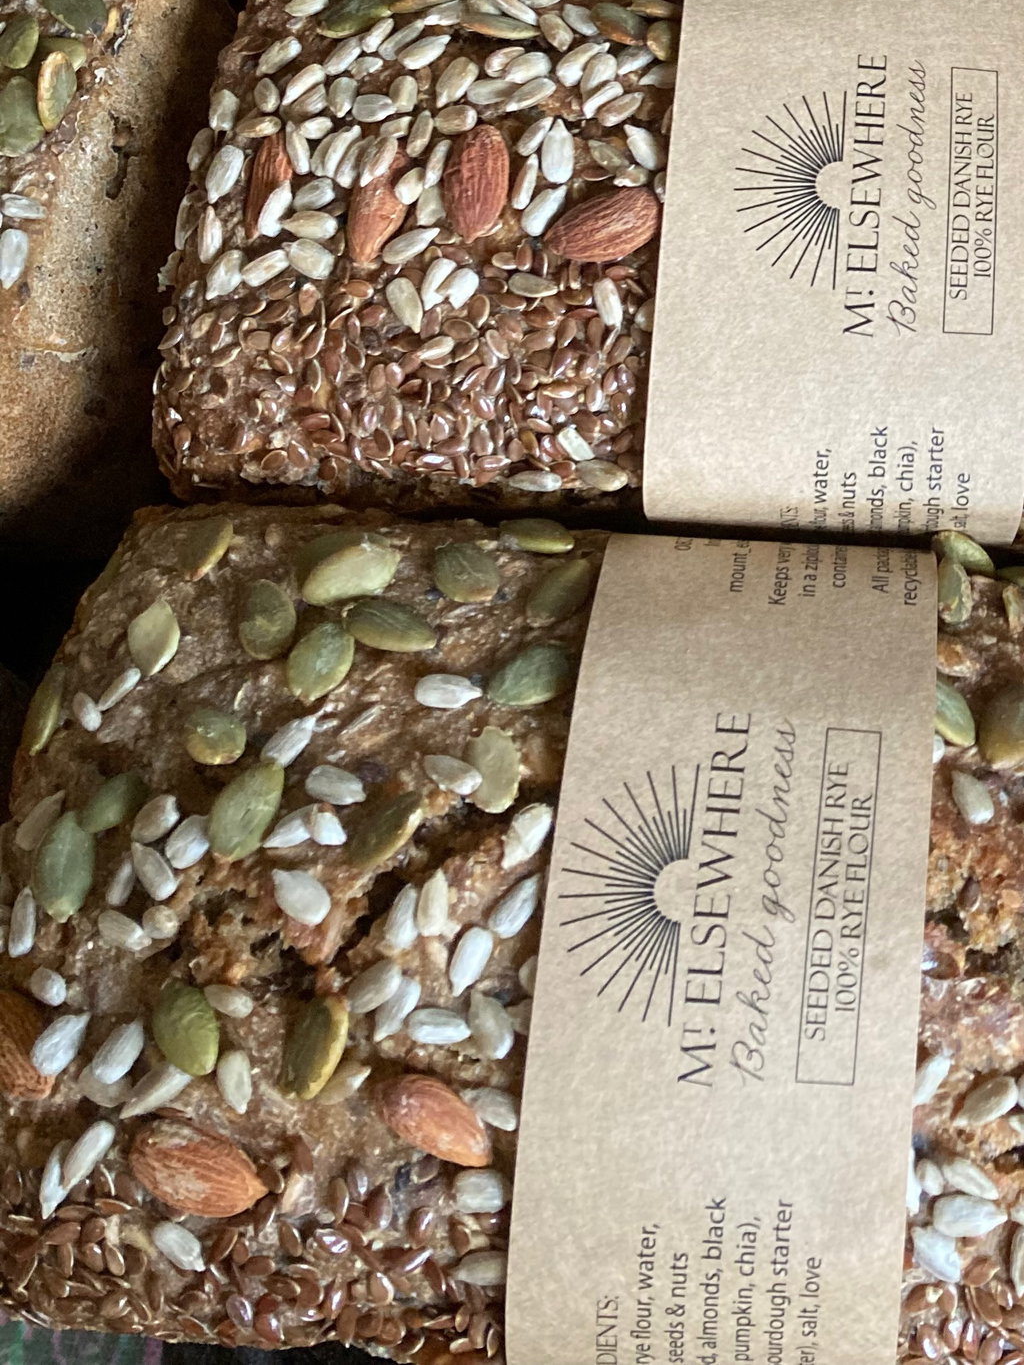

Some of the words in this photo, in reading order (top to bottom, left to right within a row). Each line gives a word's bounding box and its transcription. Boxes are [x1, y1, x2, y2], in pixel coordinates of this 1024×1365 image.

[896, 59, 937, 210] goodness
[955, 91, 973, 126] RYE
[846, 53, 887, 274] ELSEWHERE
[953, 127, 972, 209] DANISH
[976, 113, 995, 180] FLOUR
[975, 185, 994, 224] RYE
[886, 211, 920, 336] Baked
[949, 214, 971, 301] SEEDED
[973, 228, 992, 279] 100%
[812, 447, 832, 504] water,
[869, 426, 889, 478] black
[897, 440, 918, 492] chia),
[927, 427, 946, 491] starter
[842, 471, 857, 509] nuts
[953, 472, 971, 511] love
[768, 564, 792, 607] Keeps
[797, 584, 815, 598] in
[804, 573, 817, 582] a
[872, 575, 889, 594] All
[825, 761, 849, 810] RYE
[684, 712, 752, 1007] ELSEWHERE
[845, 794, 873, 884] FLOUR
[815, 817, 844, 921] DANISH
[729, 925, 776, 1088] Baked
[756, 718, 797, 924] goodness
[840, 889, 865, 940] RYE
[804, 927, 834, 1042] SEEDED
[835, 946, 860, 1013] 100%
[637, 1222, 661, 1290] water,
[702, 1197, 727, 1260] black
[735, 1216, 761, 1276] chia),
[770, 1198, 794, 1277] starter
[671, 1252, 689, 1299] nuts
[799, 1256, 823, 1298] love
[595, 1295, 620, 1365] DIENTS:
[630, 1296, 655, 1340] flour,
[665, 1303, 685, 1316] &
[696, 1270, 723, 1352] almonds,
[731, 1283, 757, 1362] pumpkin,
[796, 1303, 821, 1338] salt,
[667, 1322, 685, 1363] seeds
